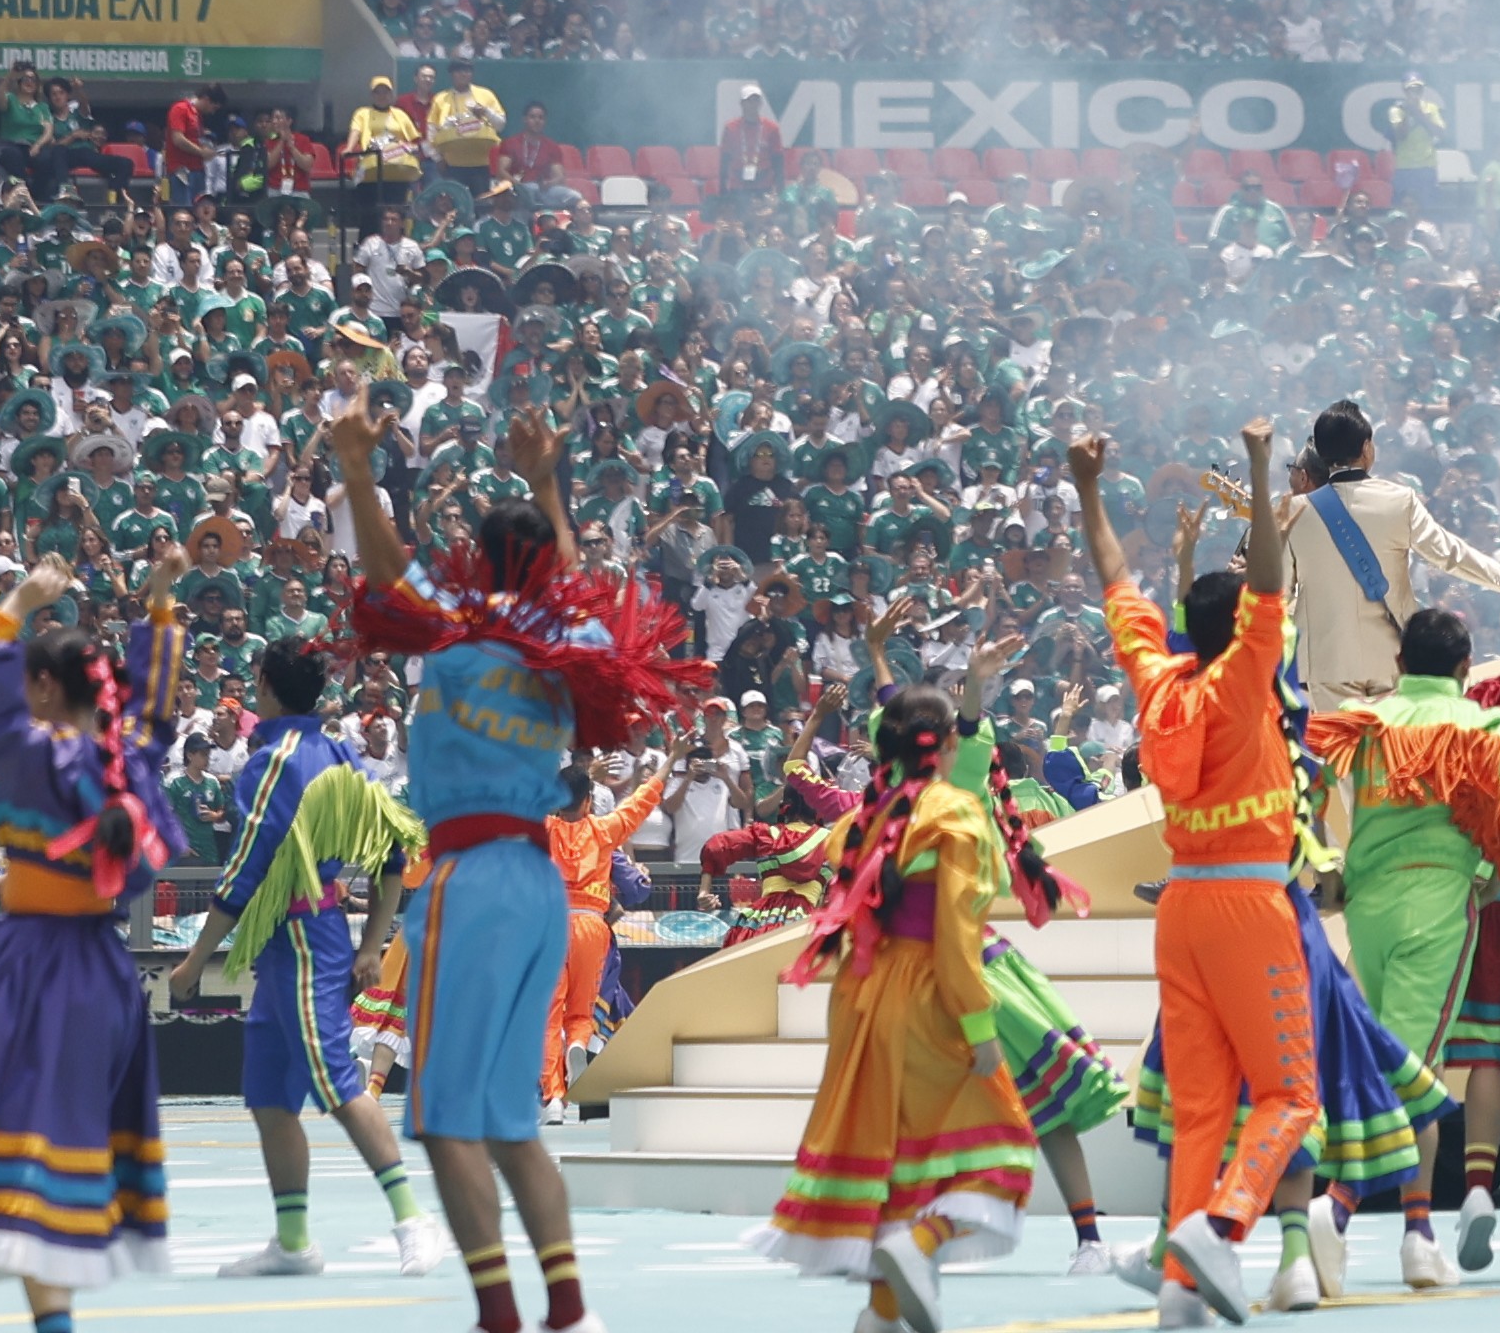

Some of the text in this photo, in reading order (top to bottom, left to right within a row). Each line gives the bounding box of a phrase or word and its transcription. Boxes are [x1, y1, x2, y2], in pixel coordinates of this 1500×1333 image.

[36, 48, 57, 71] DE
[60, 49, 169, 73] EMERGENCIA
[715, 78, 1306, 152] MEXICO
